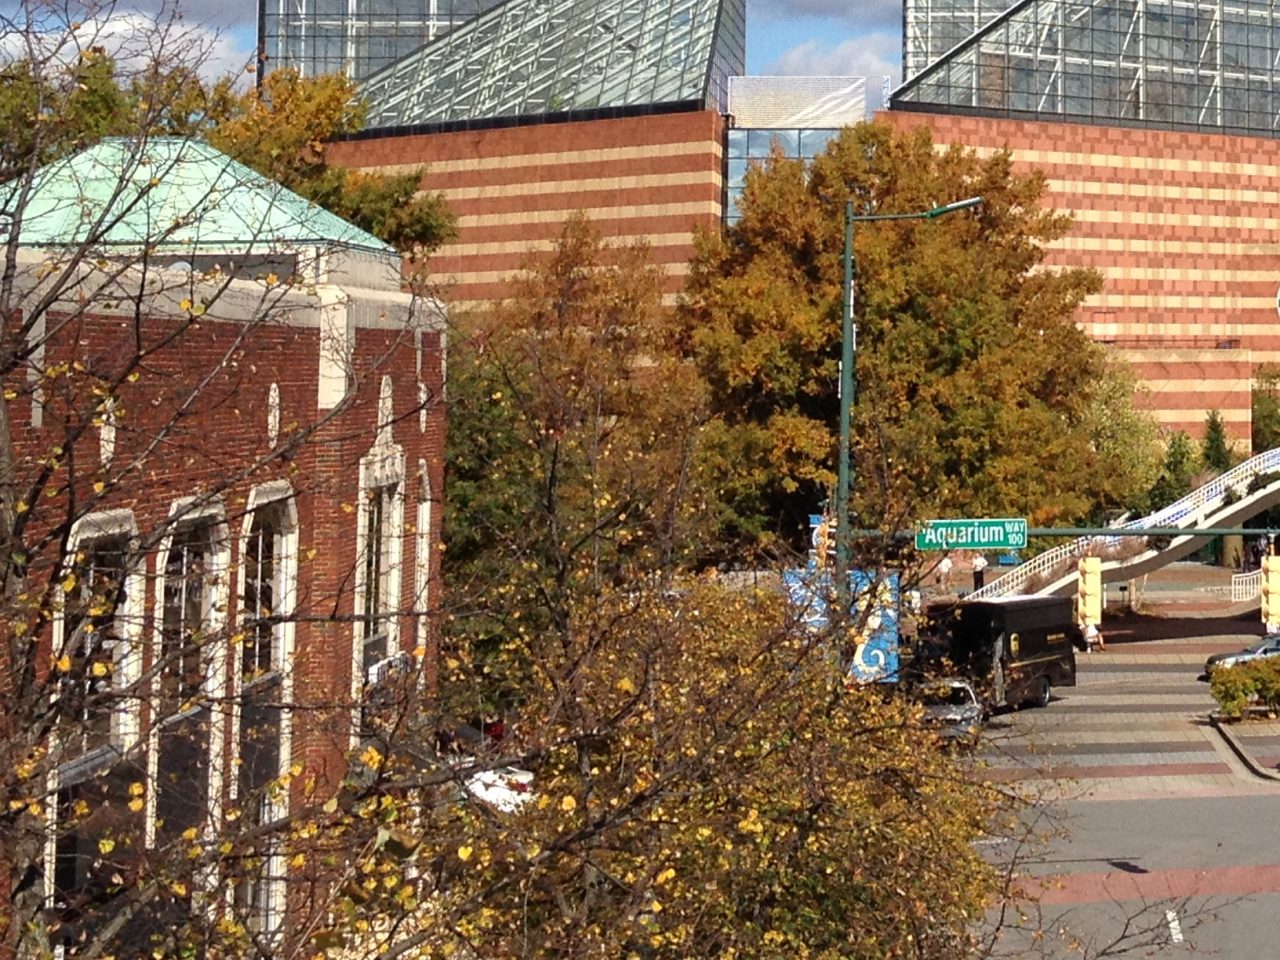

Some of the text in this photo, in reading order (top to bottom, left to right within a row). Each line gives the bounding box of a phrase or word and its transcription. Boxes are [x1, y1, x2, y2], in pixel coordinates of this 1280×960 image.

[924, 522, 1025, 549] Aquarium WAY
[1007, 533, 1023, 545] 100
